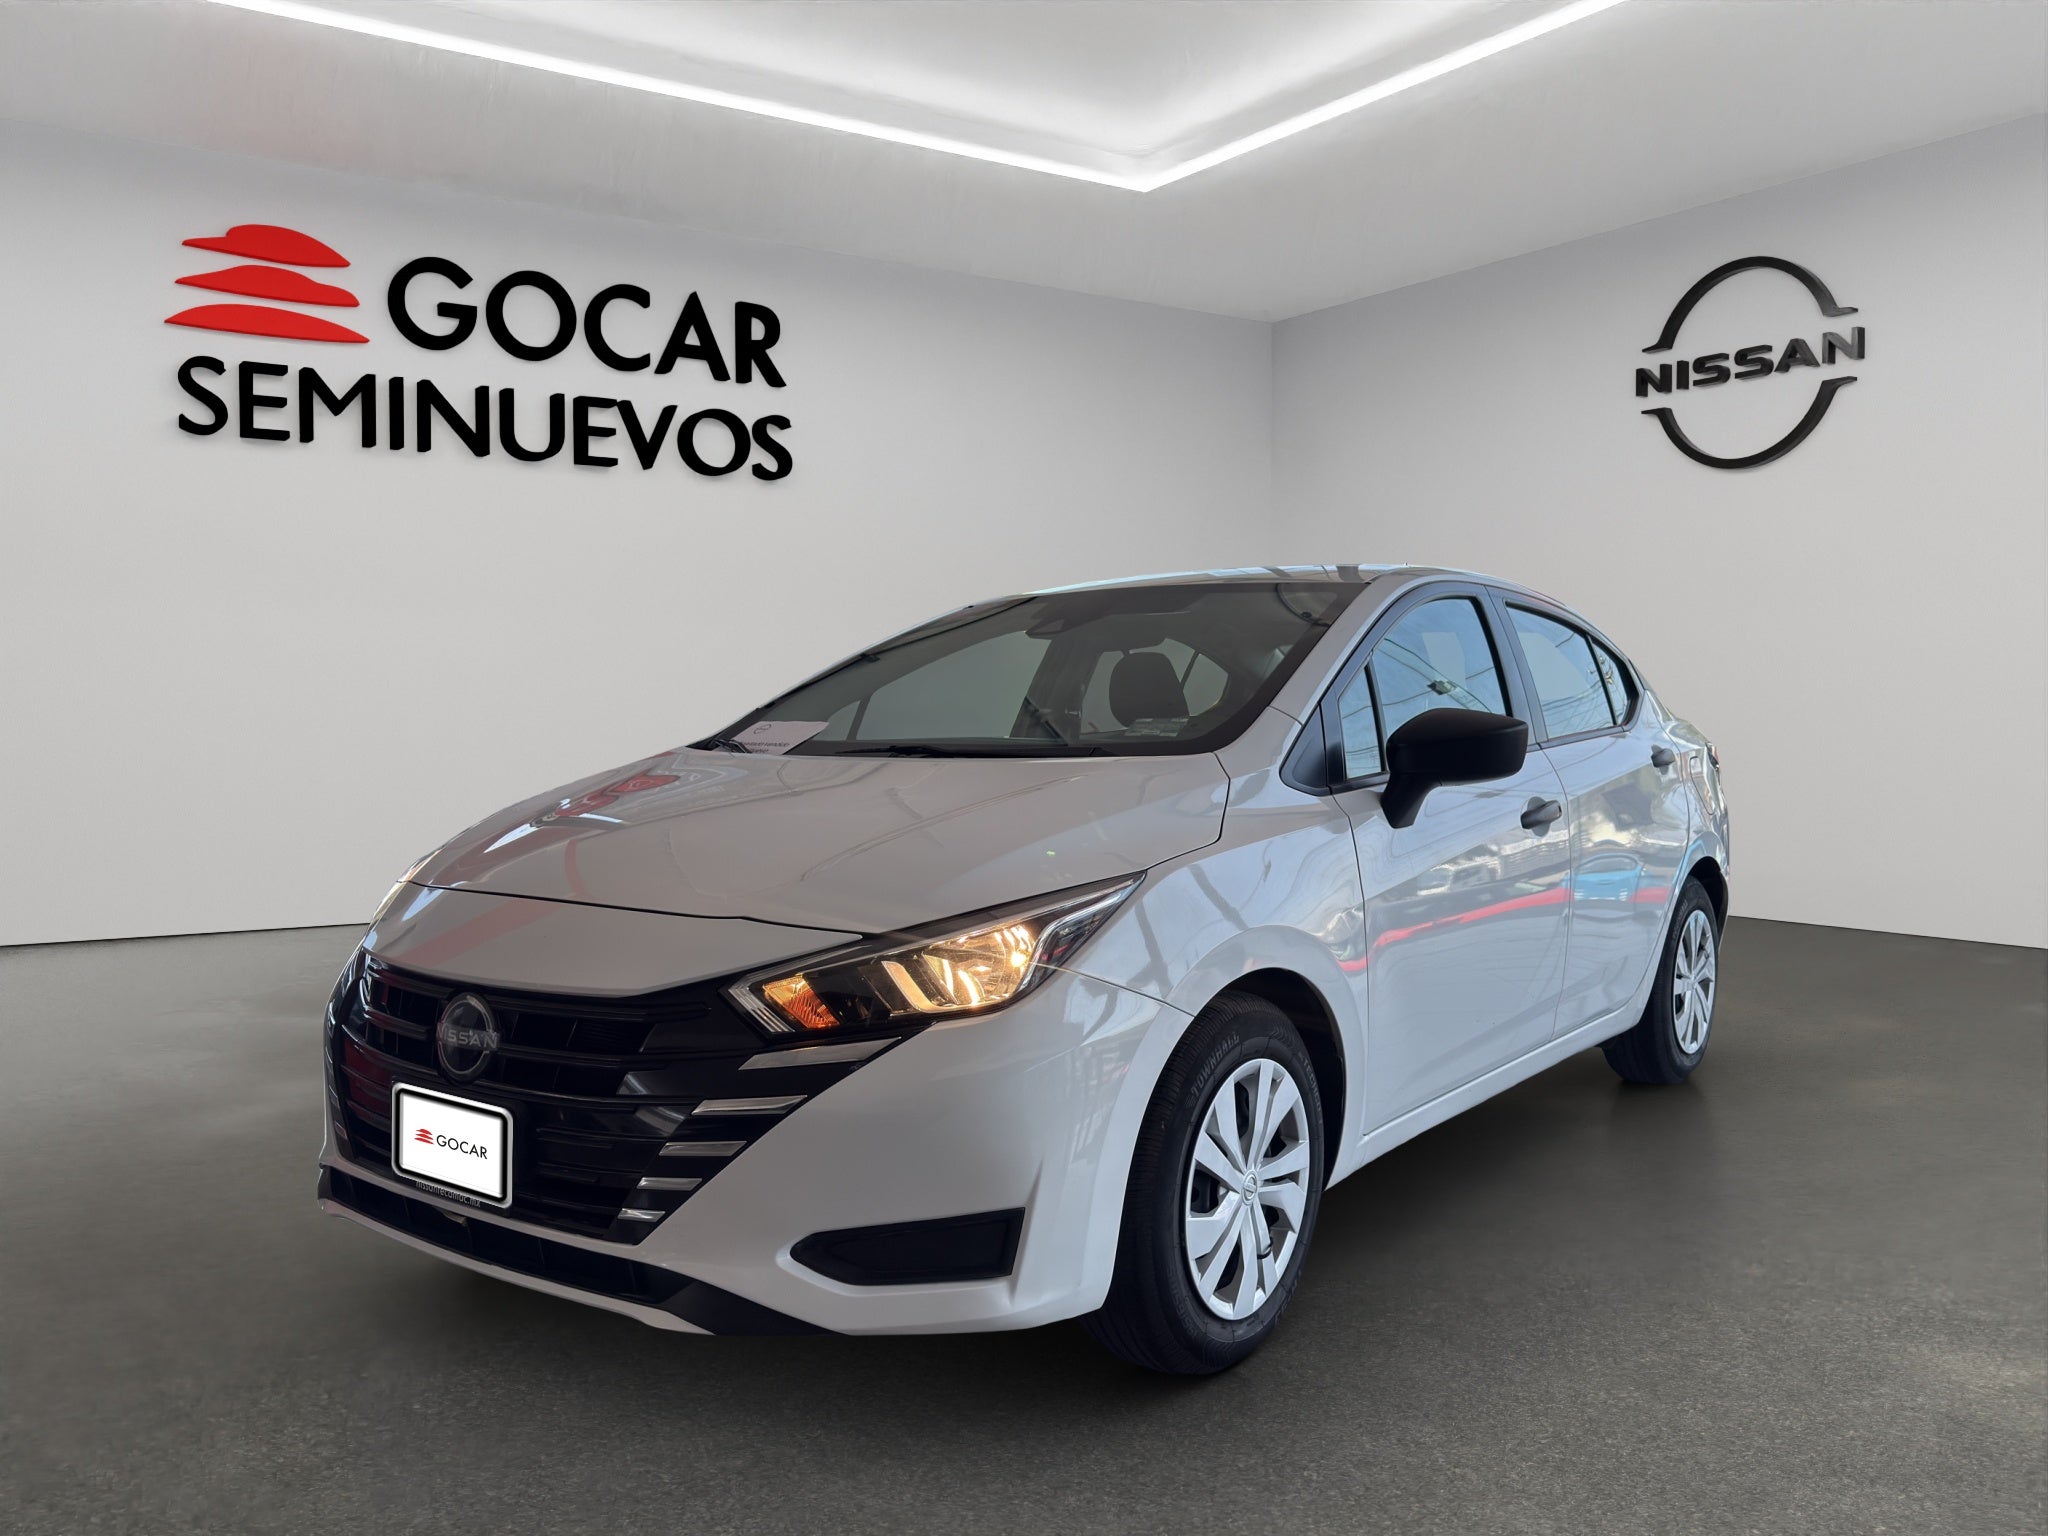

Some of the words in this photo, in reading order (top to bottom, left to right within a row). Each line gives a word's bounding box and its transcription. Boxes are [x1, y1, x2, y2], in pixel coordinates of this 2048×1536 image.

[387, 255, 788, 388] GOCAR
[1635, 326, 1866, 398] NISSAN
[176, 355, 794, 482] SEMINUEVOS
[436, 1134, 488, 1160] GOCAR
